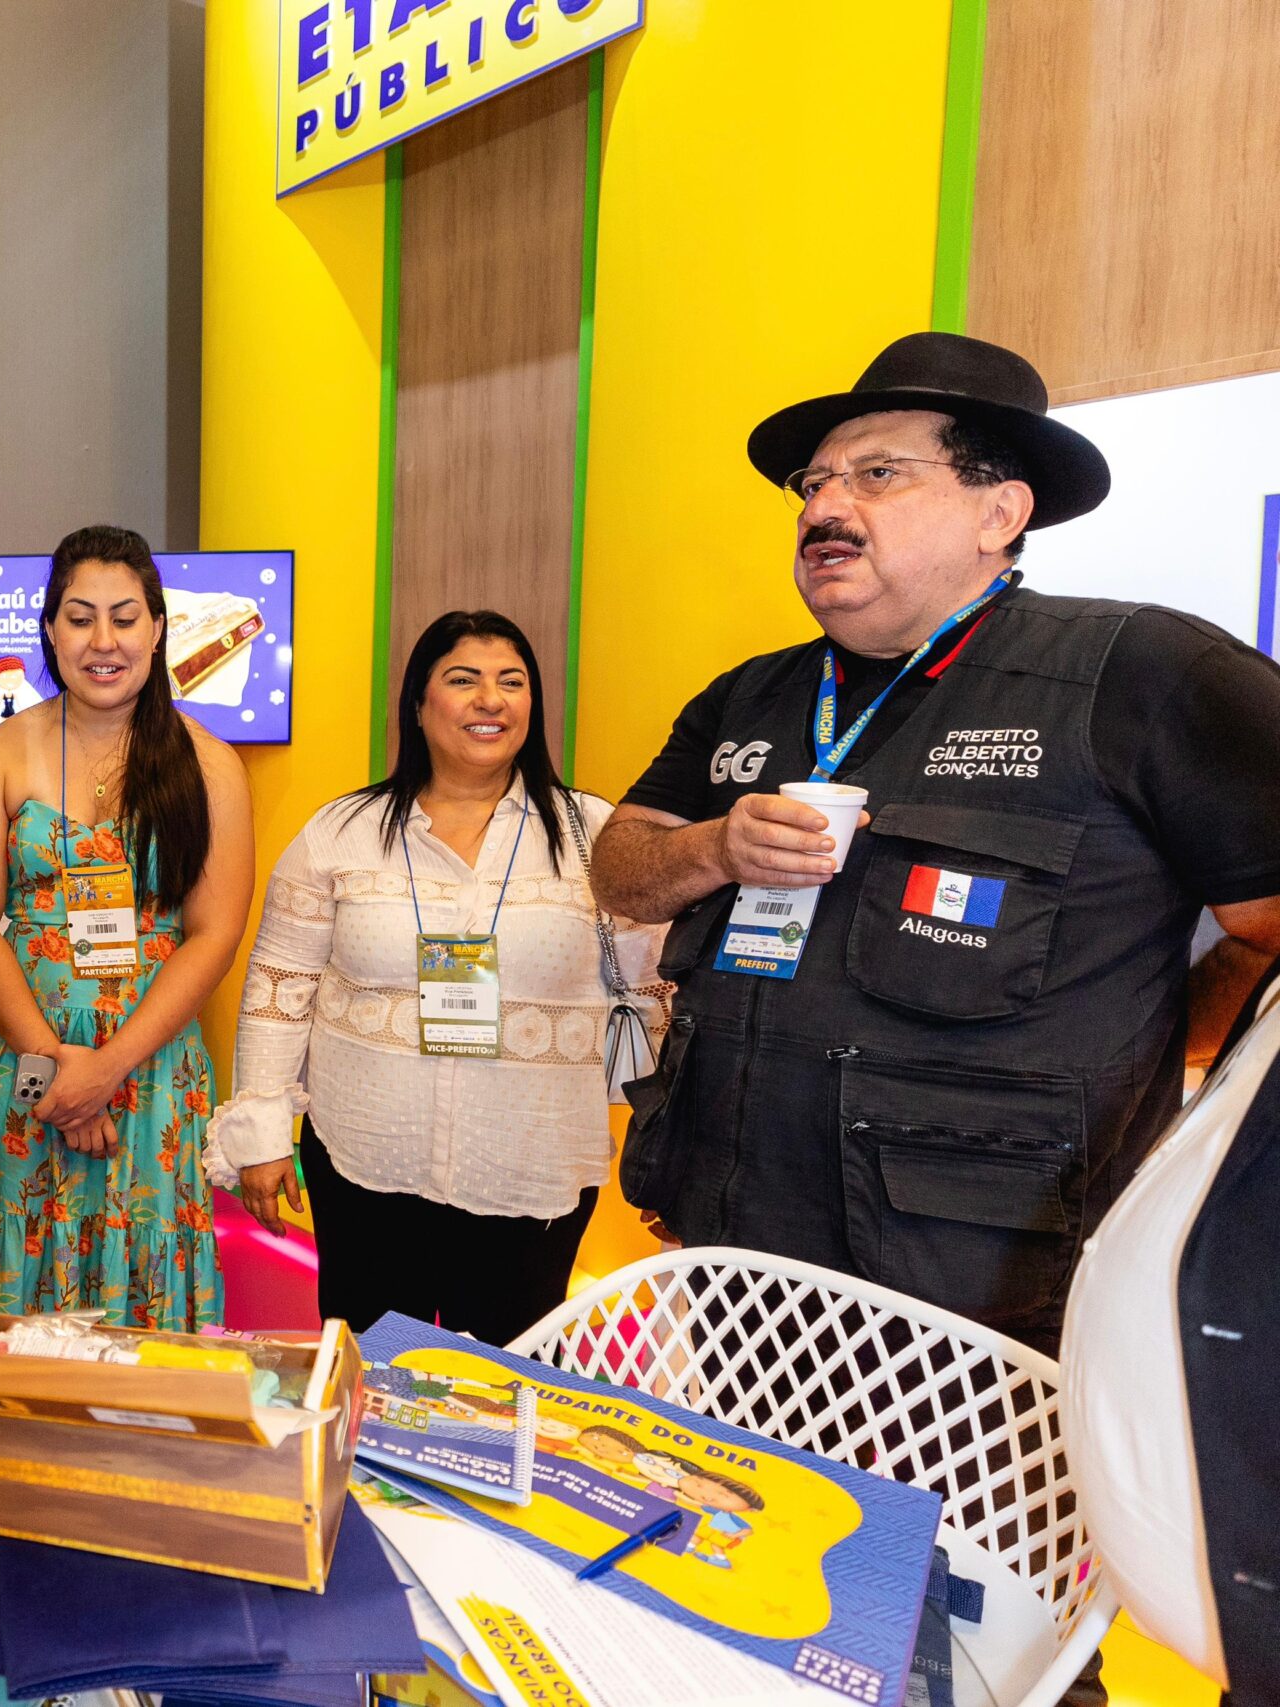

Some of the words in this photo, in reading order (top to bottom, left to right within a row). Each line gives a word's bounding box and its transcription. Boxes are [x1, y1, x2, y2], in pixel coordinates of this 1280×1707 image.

[30, 587, 45, 609] d
[10, 636, 41, 645] pedagóg
[819, 695, 834, 744] MARCHA
[827, 708, 876, 763] MARCHA
[945, 729, 1039, 744] PREFEITO
[710, 740, 773, 784] GG
[929, 745, 1043, 763] GILBERTO
[924, 763, 1039, 781] GONÇALVES
[899, 917, 988, 949] Alagoas
[80, 967, 134, 976] PARTICIPANTE
[735, 959, 778, 971] PREFEITO
[426, 1044, 496, 1055] VICE-PREFEITO(A)
[503, 1380, 643, 1427] AUDANTE
[651, 1425, 693, 1446] DO
[705, 1445, 757, 1471] DIA
[382, 1443, 412, 1456] de
[424, 1446, 511, 1475] teórica
[416, 1453, 511, 1485] Manual
[532, 1471, 560, 1483] ome
[563, 1481, 582, 1494] da
[585, 1492, 636, 1518] criança
[556, 1470, 590, 1488] para
[593, 1486, 644, 1511] colocar
[503, 1613, 558, 1674] BRASIL
